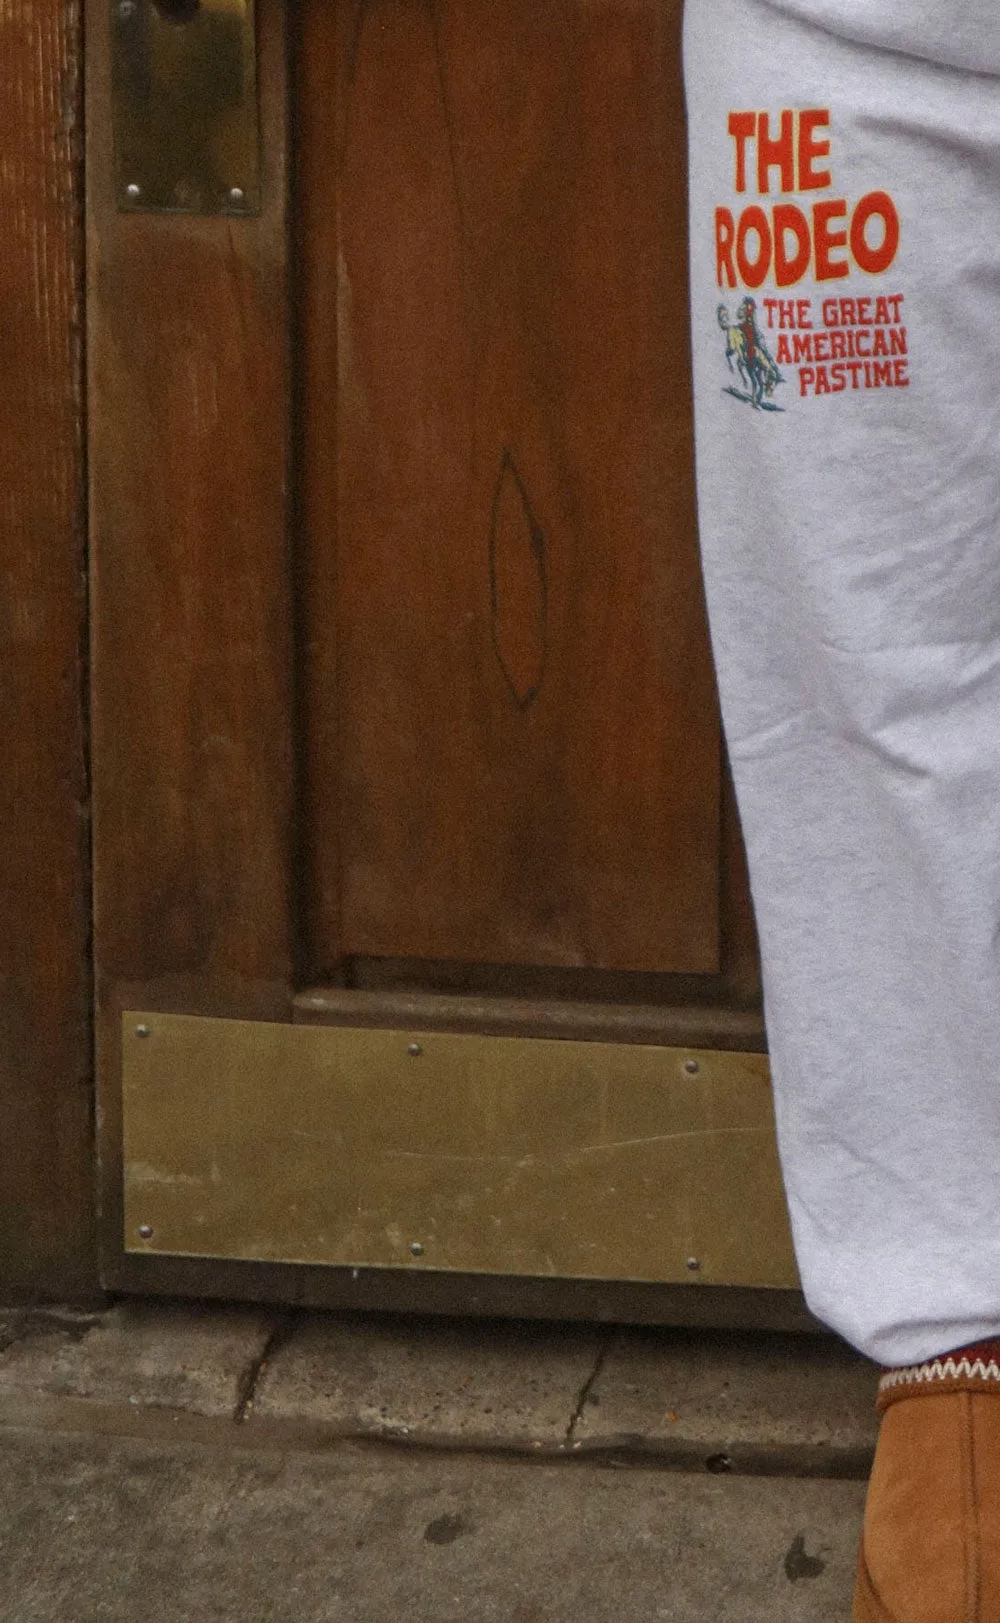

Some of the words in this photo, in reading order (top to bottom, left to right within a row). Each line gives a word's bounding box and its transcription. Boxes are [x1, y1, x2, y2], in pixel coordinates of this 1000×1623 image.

[727, 108, 832, 195] THE
[713, 190, 900, 290] RODEO
[763, 298, 813, 330] THE
[822, 294, 904, 326] GREAT
[775, 327, 909, 364] AMERICAN
[799, 359, 910, 397] PASTIME
